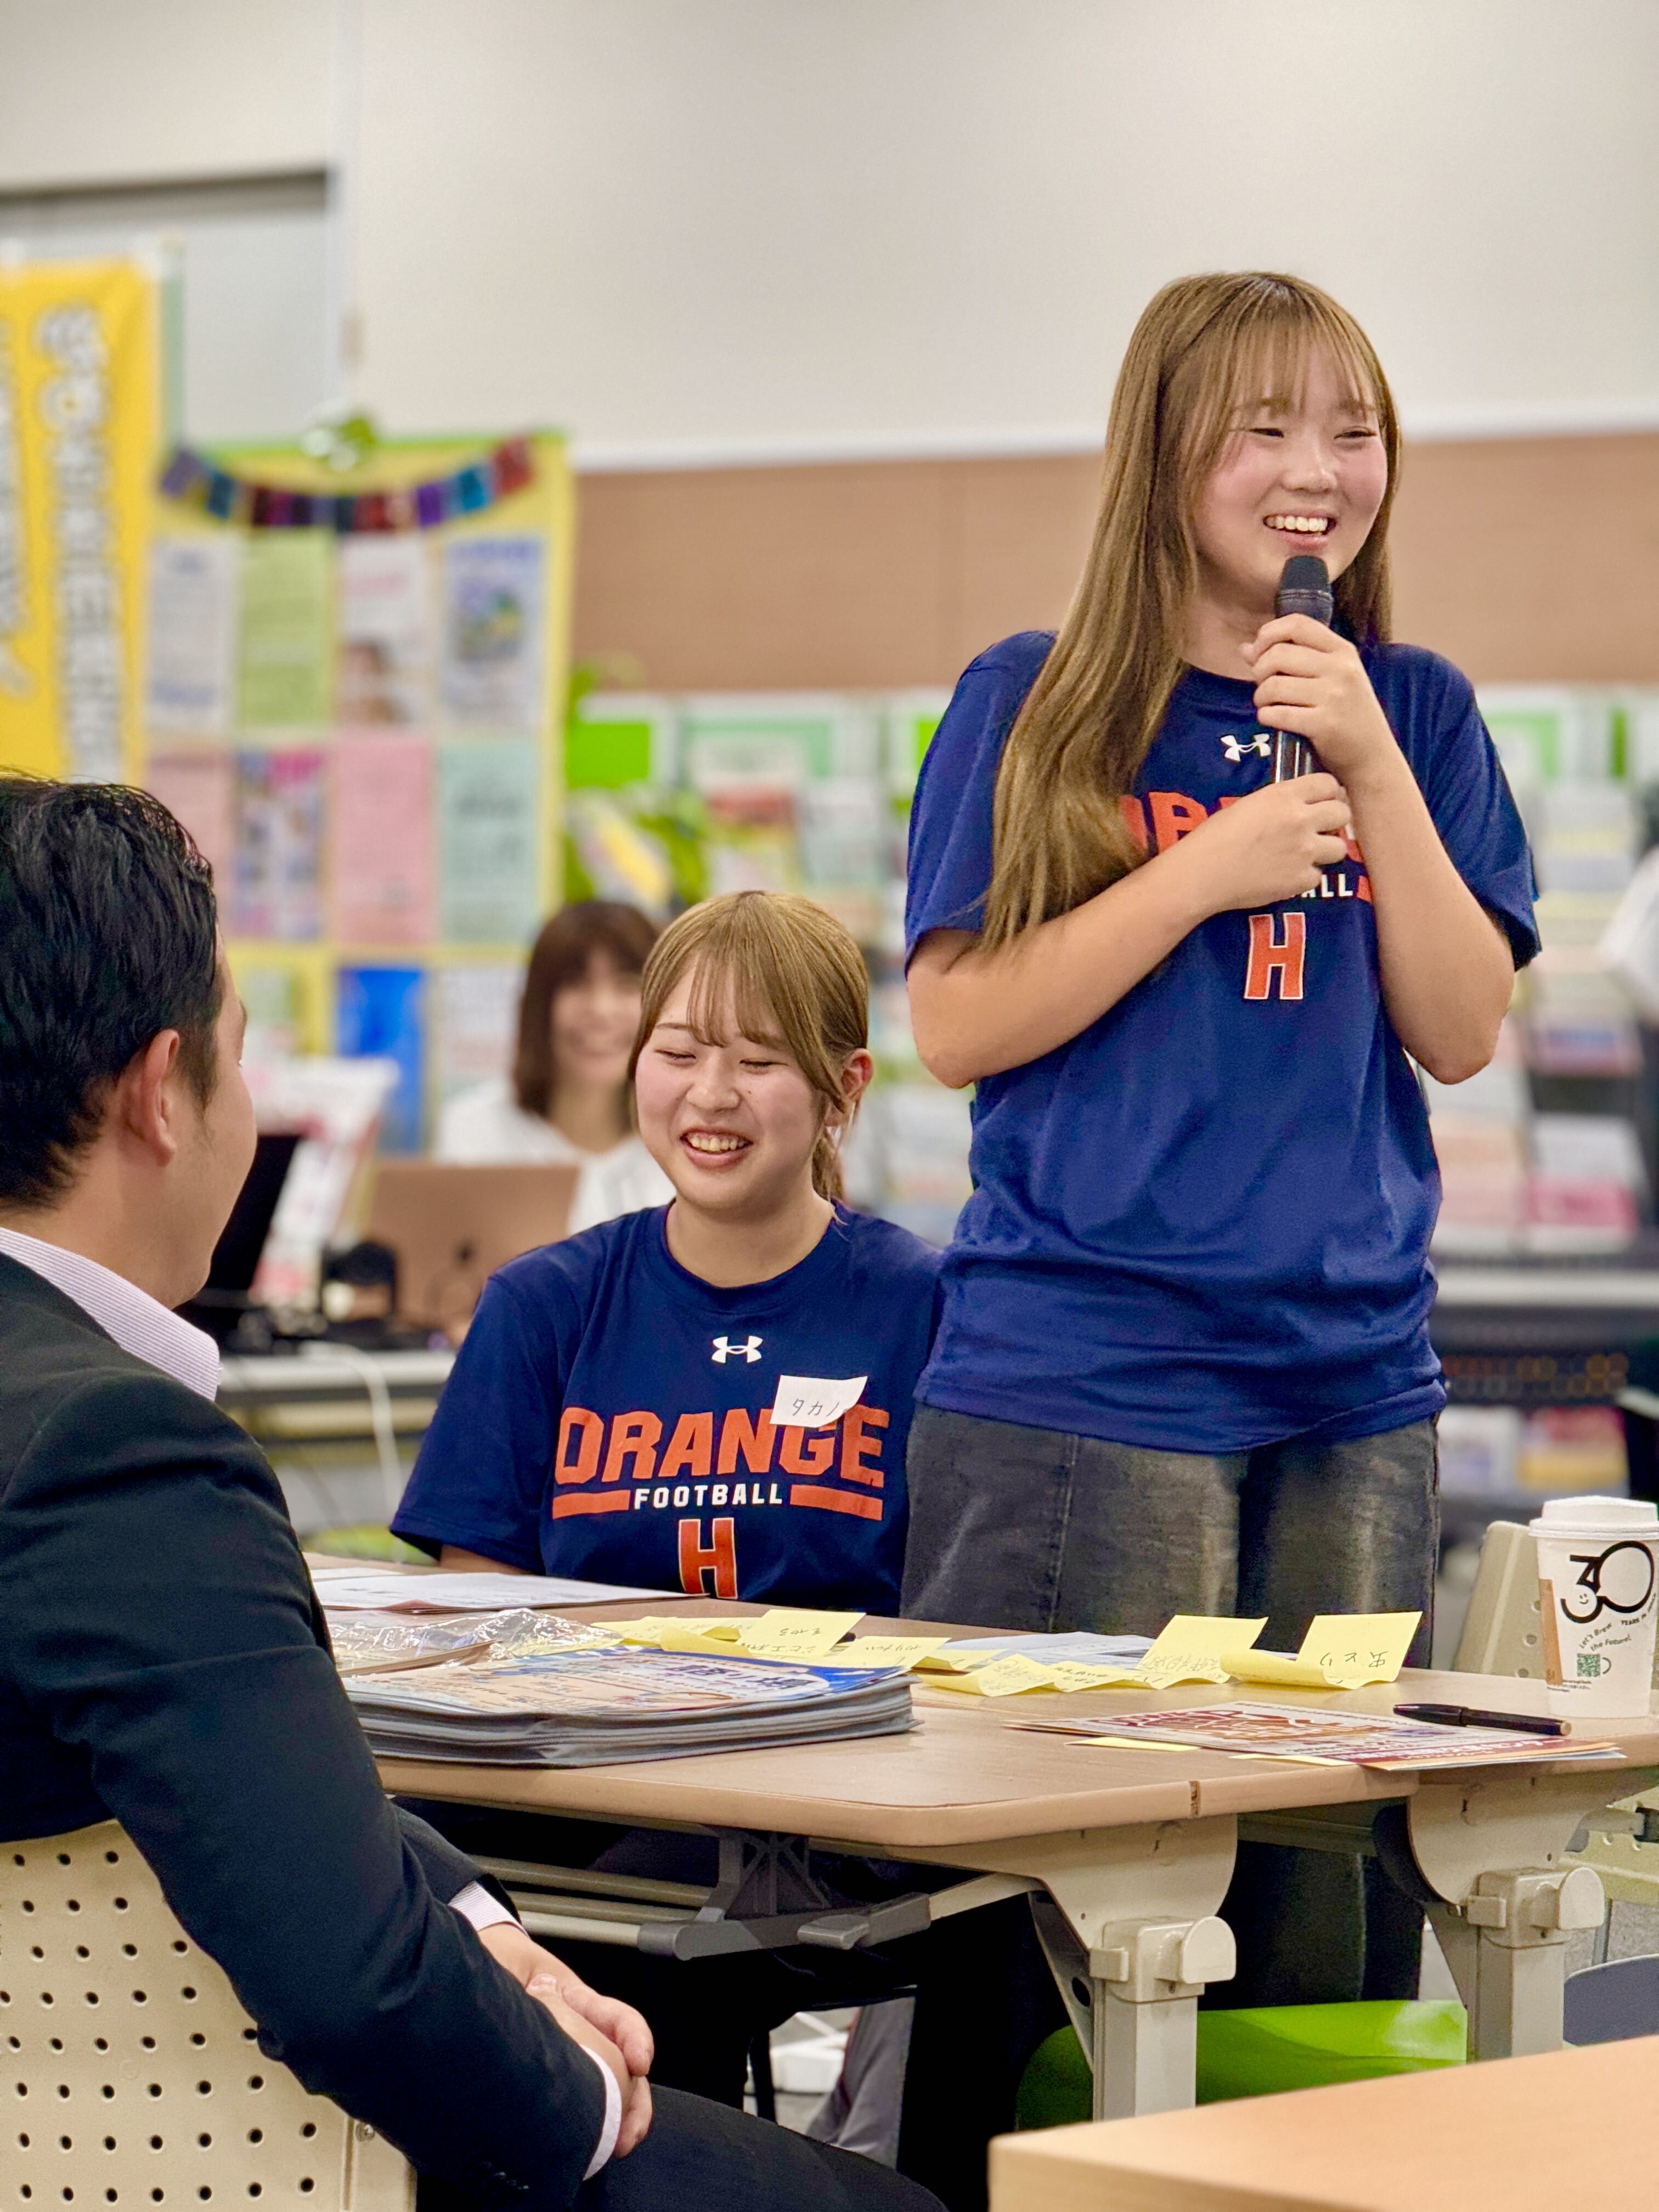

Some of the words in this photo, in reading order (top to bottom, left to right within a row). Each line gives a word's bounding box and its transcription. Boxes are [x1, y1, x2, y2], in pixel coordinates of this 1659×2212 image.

[1244, 912, 1306, 1000] H
[792, 1398, 840, 1417] タカノ
[554, 1406, 890, 1488] ORANGE
[634, 1483, 783, 1510] FOOTBALL
[678, 1517, 738, 1600] H
[1560, 1541, 1655, 1624] 30
[1319, 1650, 1389, 1669] 虫とり
[1590, 1641, 1604, 1651] the
